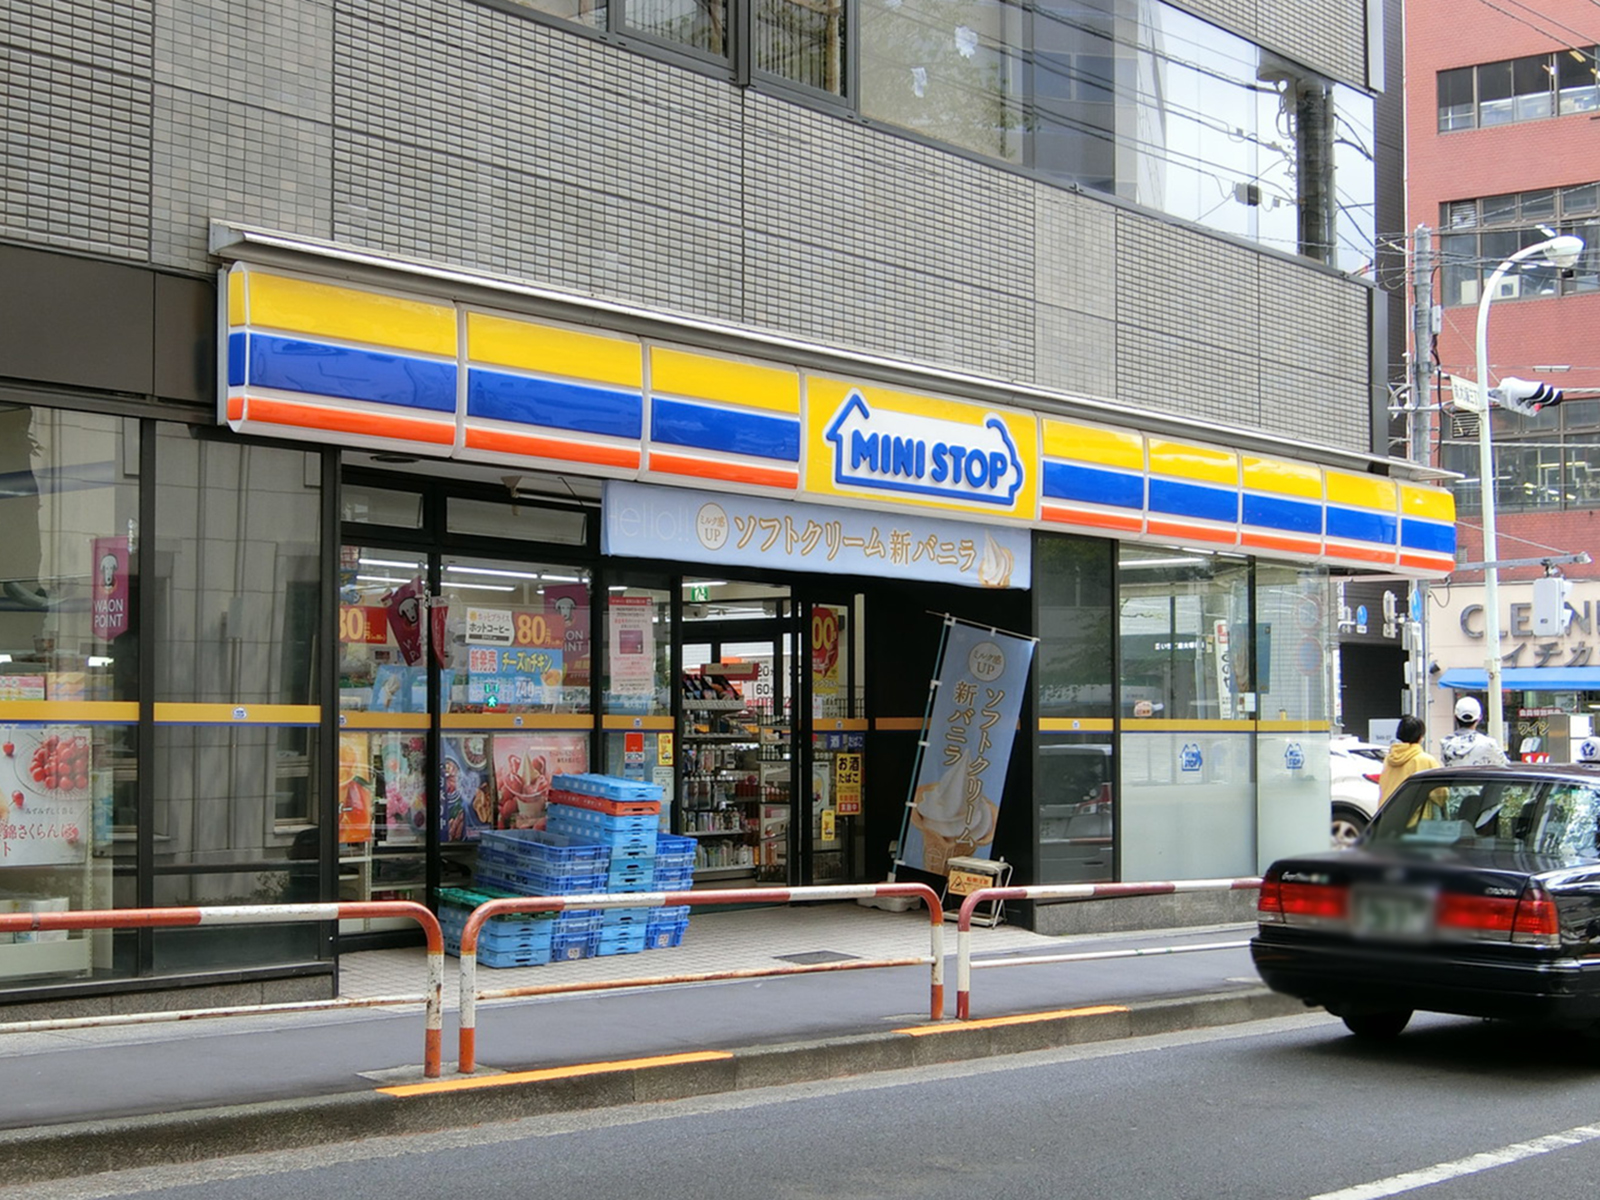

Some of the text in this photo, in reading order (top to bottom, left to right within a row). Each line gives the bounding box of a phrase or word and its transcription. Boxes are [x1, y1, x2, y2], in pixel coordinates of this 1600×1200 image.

[851, 429, 1008, 489] MINI STOP
[704, 528, 721, 542] UP
[733, 514, 977, 573] ソフトクリーム新バニラ
[94, 598, 124, 613] WAON
[94, 613, 124, 628] POINT
[1460, 600, 1600, 639] CEN
[468, 623, 510, 634] ホットコーヒー
[517, 614, 547, 645] 80
[1501, 642, 1593, 669] イチカ
[976, 661, 996, 675] UP
[943, 680, 979, 767] 新バニラ
[838, 756, 860, 772] お酒
[954, 686, 1005, 848] ソフトクリーム
[837, 773, 860, 784] たばこ
[0, 823, 79, 840] 錦さくらんぼ
